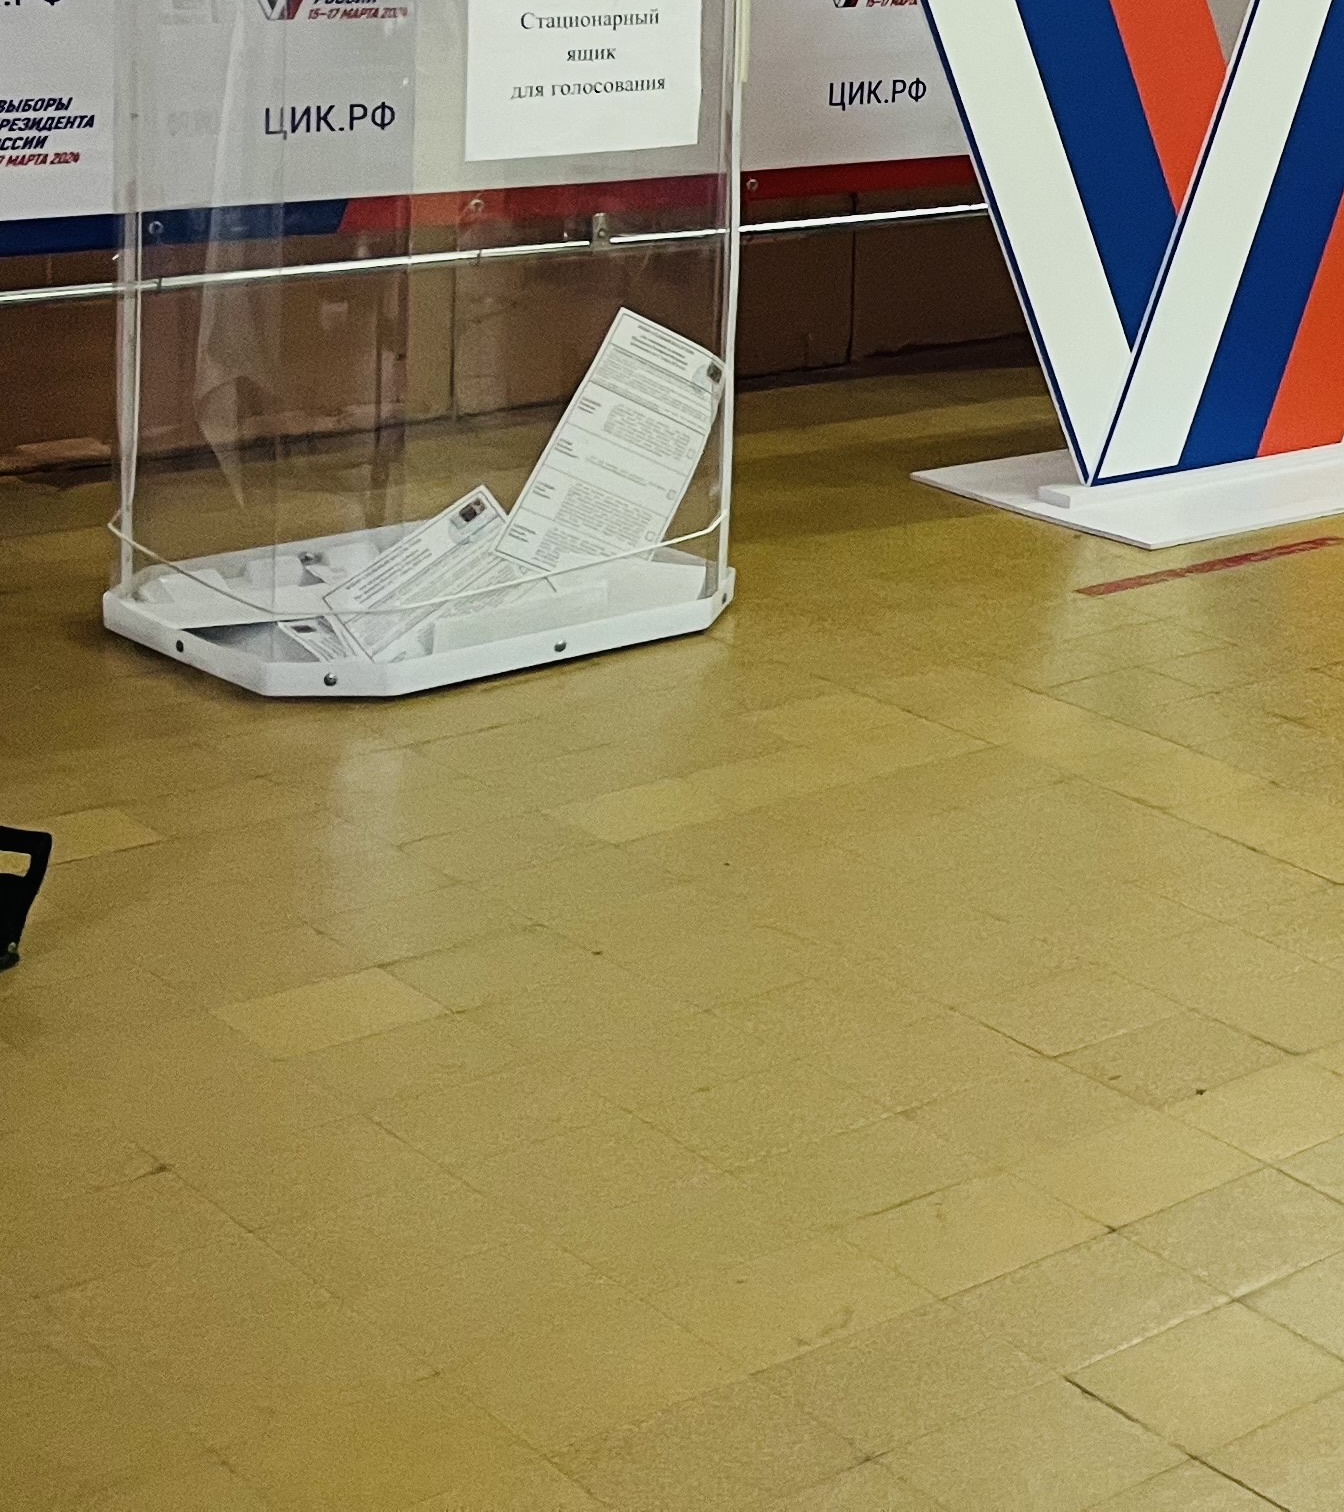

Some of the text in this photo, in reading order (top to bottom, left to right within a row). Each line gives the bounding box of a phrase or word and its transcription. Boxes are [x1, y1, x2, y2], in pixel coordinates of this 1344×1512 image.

[520, 8, 660, 31] Стационарный
[567, 47, 617, 62] ящик
[510, 77, 666, 100] для голосования
[829, 77, 927, 111] ЦИК.РФ
[0, 115, 95, 133] РЕЗИДЕНТА
[265, 101, 396, 140] ЦИК.РФ
[0, 136, 49, 152] ССИИ
[6, 152, 48, 168] МАРТА
